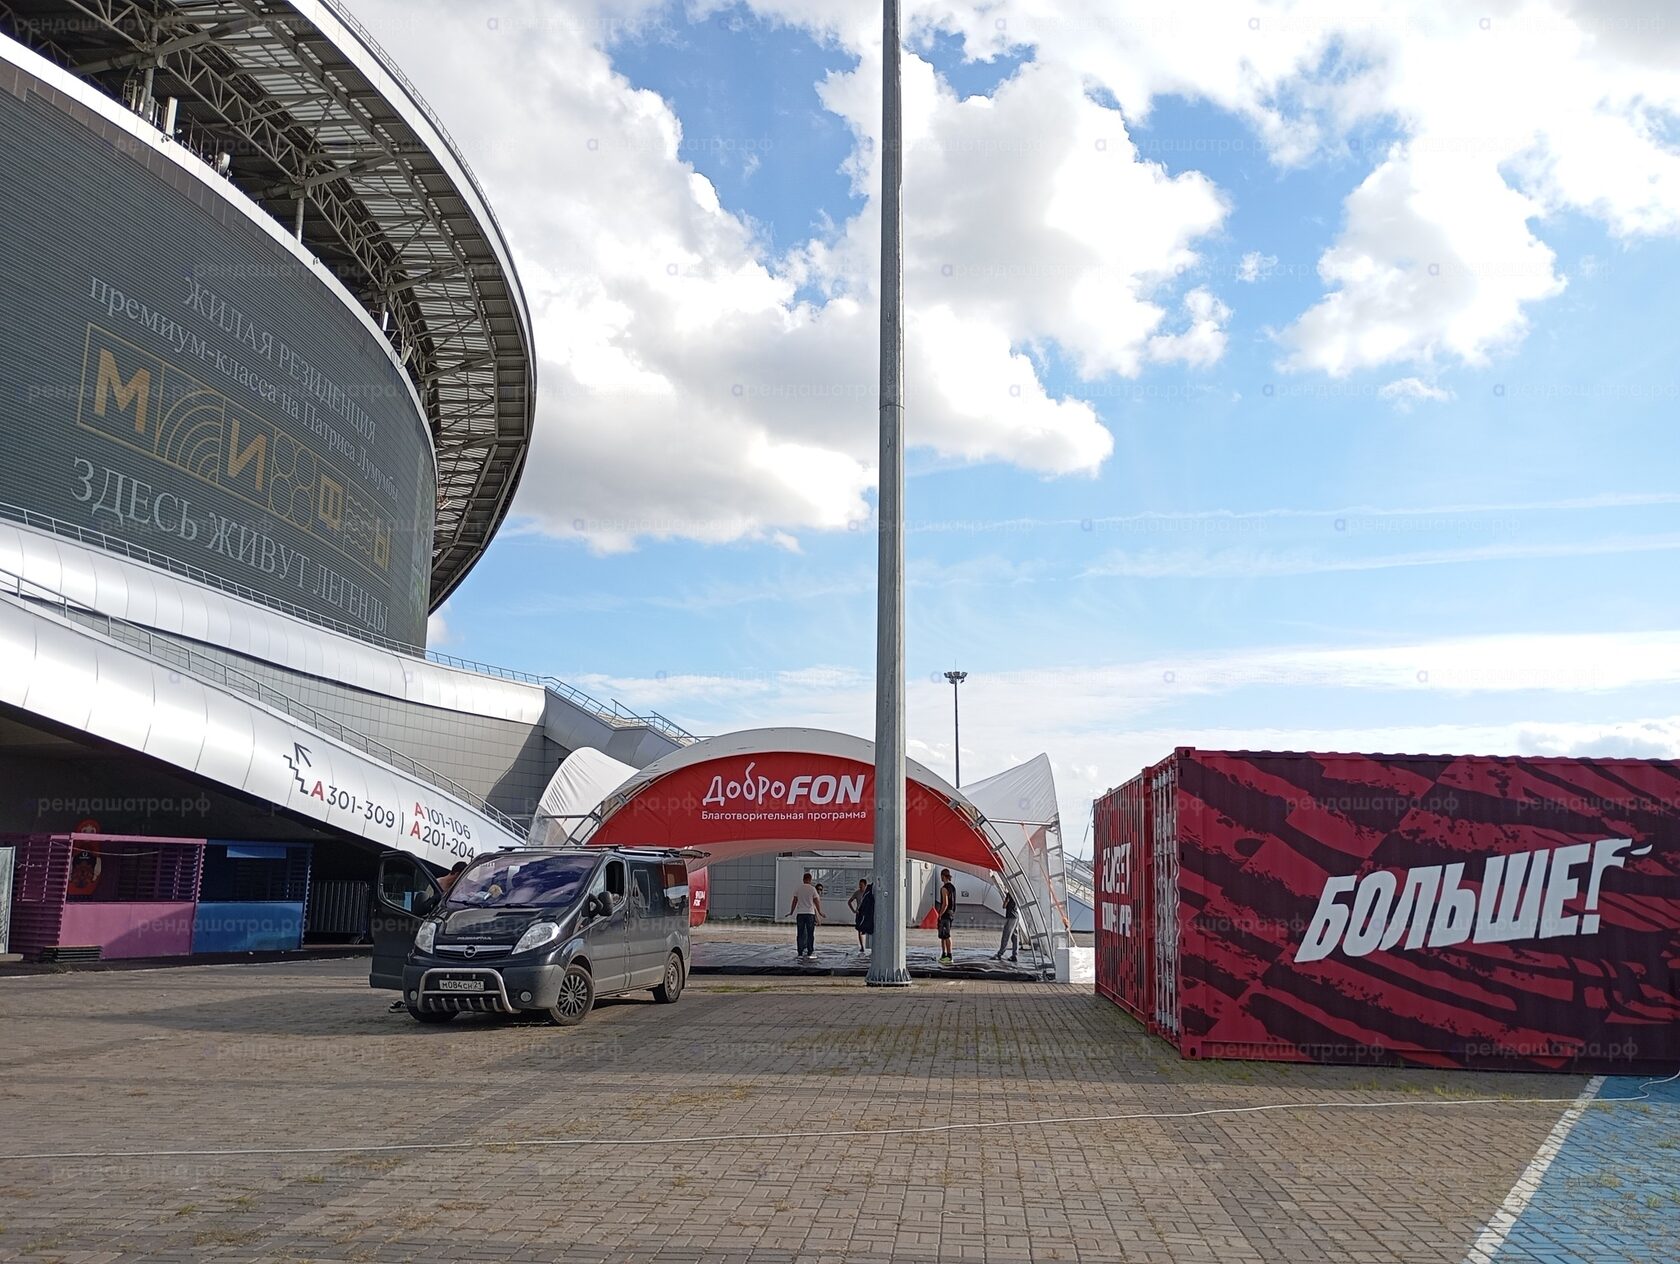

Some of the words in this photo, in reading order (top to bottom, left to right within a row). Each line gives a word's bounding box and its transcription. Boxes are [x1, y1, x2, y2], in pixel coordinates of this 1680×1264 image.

[89, 276, 277, 403] премиум-класса
[282, 397, 300, 419] на
[302, 406, 358, 464] Патриса
[183, 276, 272, 363] ЖИЛАЯ
[279, 343, 377, 445] РЕЗИДЕНЦИЯ
[70, 457, 200, 542] ЗДЕСЬ
[207, 512, 312, 588] ЖИВУТ
[312, 562, 390, 636] ЛЕГЕНДЫ
[702, 810, 804, 821] Благотворительная
[807, 810, 867, 822] программа
